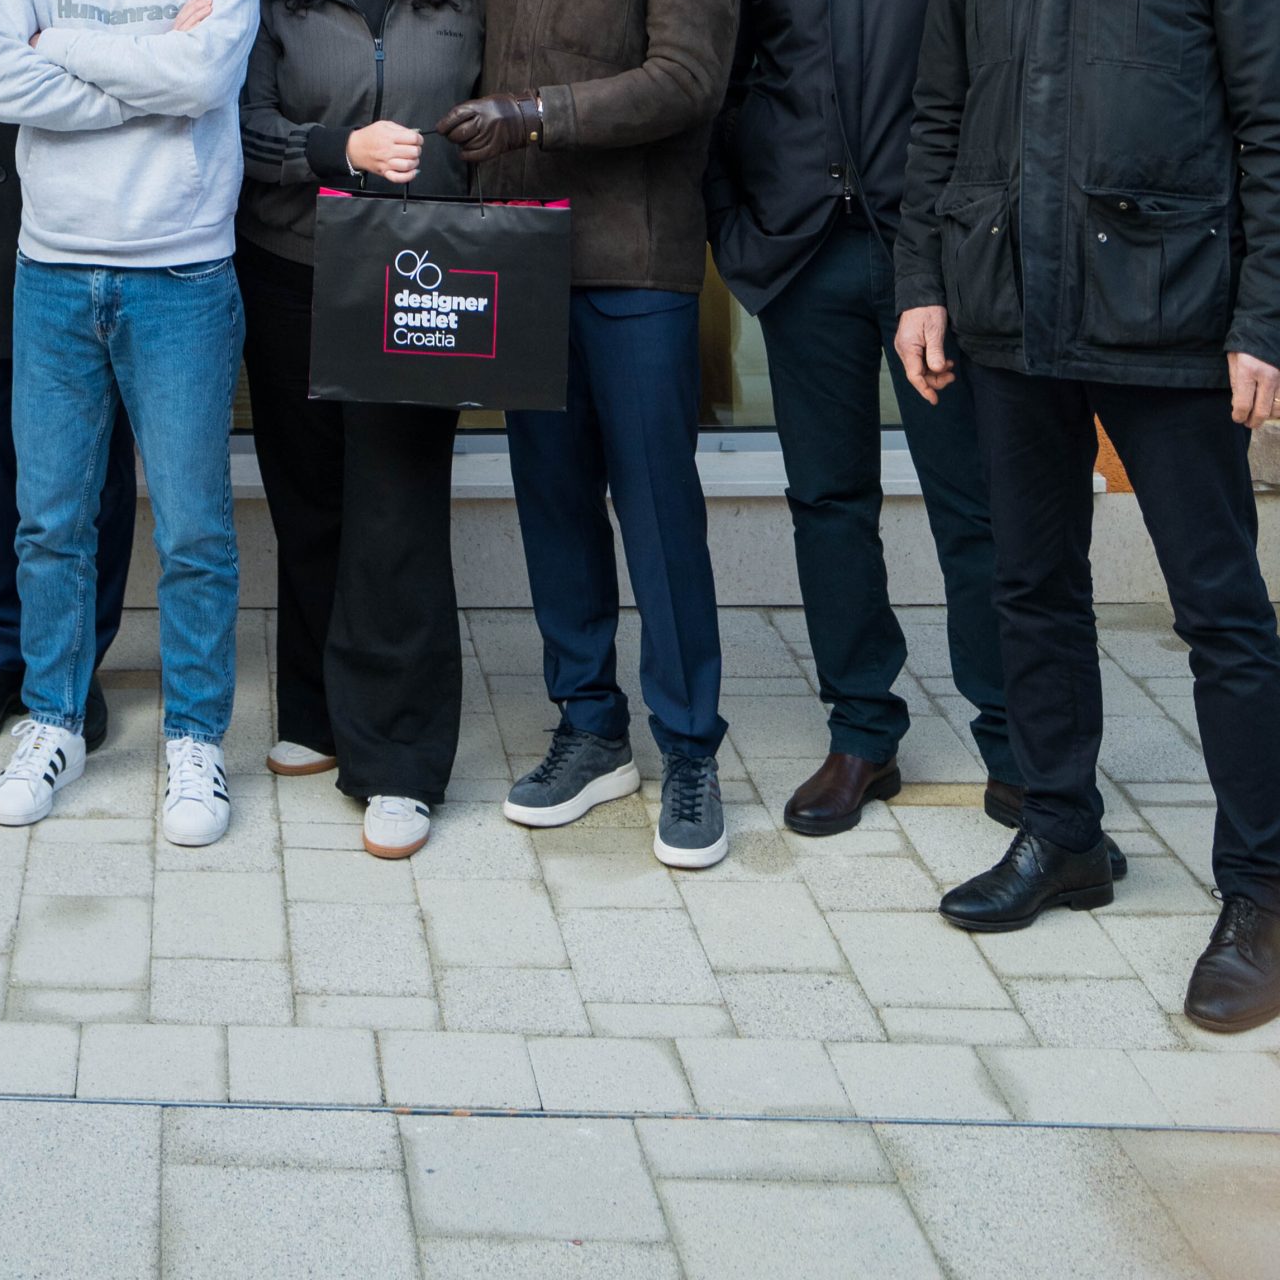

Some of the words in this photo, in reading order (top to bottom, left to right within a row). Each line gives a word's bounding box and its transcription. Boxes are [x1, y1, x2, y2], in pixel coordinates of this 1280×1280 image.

[394, 289, 488, 312] designer
[393, 310, 458, 329] outlet
[393, 328, 456, 347] Croatia
